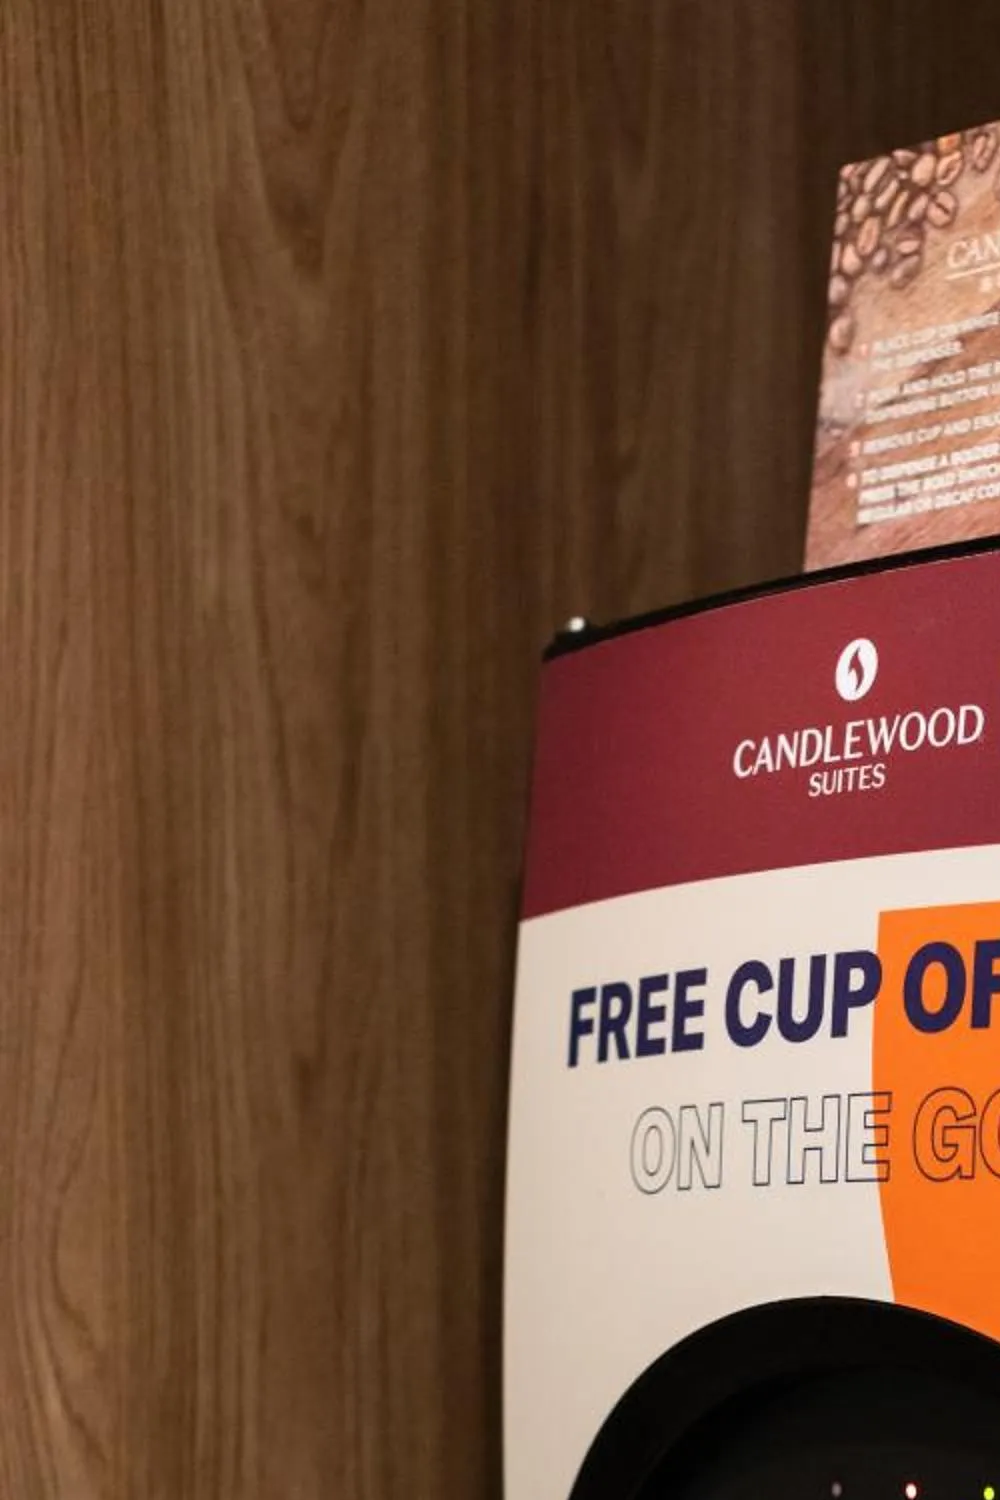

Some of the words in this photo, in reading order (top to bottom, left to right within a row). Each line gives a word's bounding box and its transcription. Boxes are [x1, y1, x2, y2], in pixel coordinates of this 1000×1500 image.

[733, 704, 985, 779] CANDLEWOOD
[808, 763, 886, 797] SUITES
[567, 967, 708, 1068] FREE
[724, 949, 883, 1048] CUP
[628, 1101, 725, 1195] ON
[741, 1091, 893, 1186] THE
